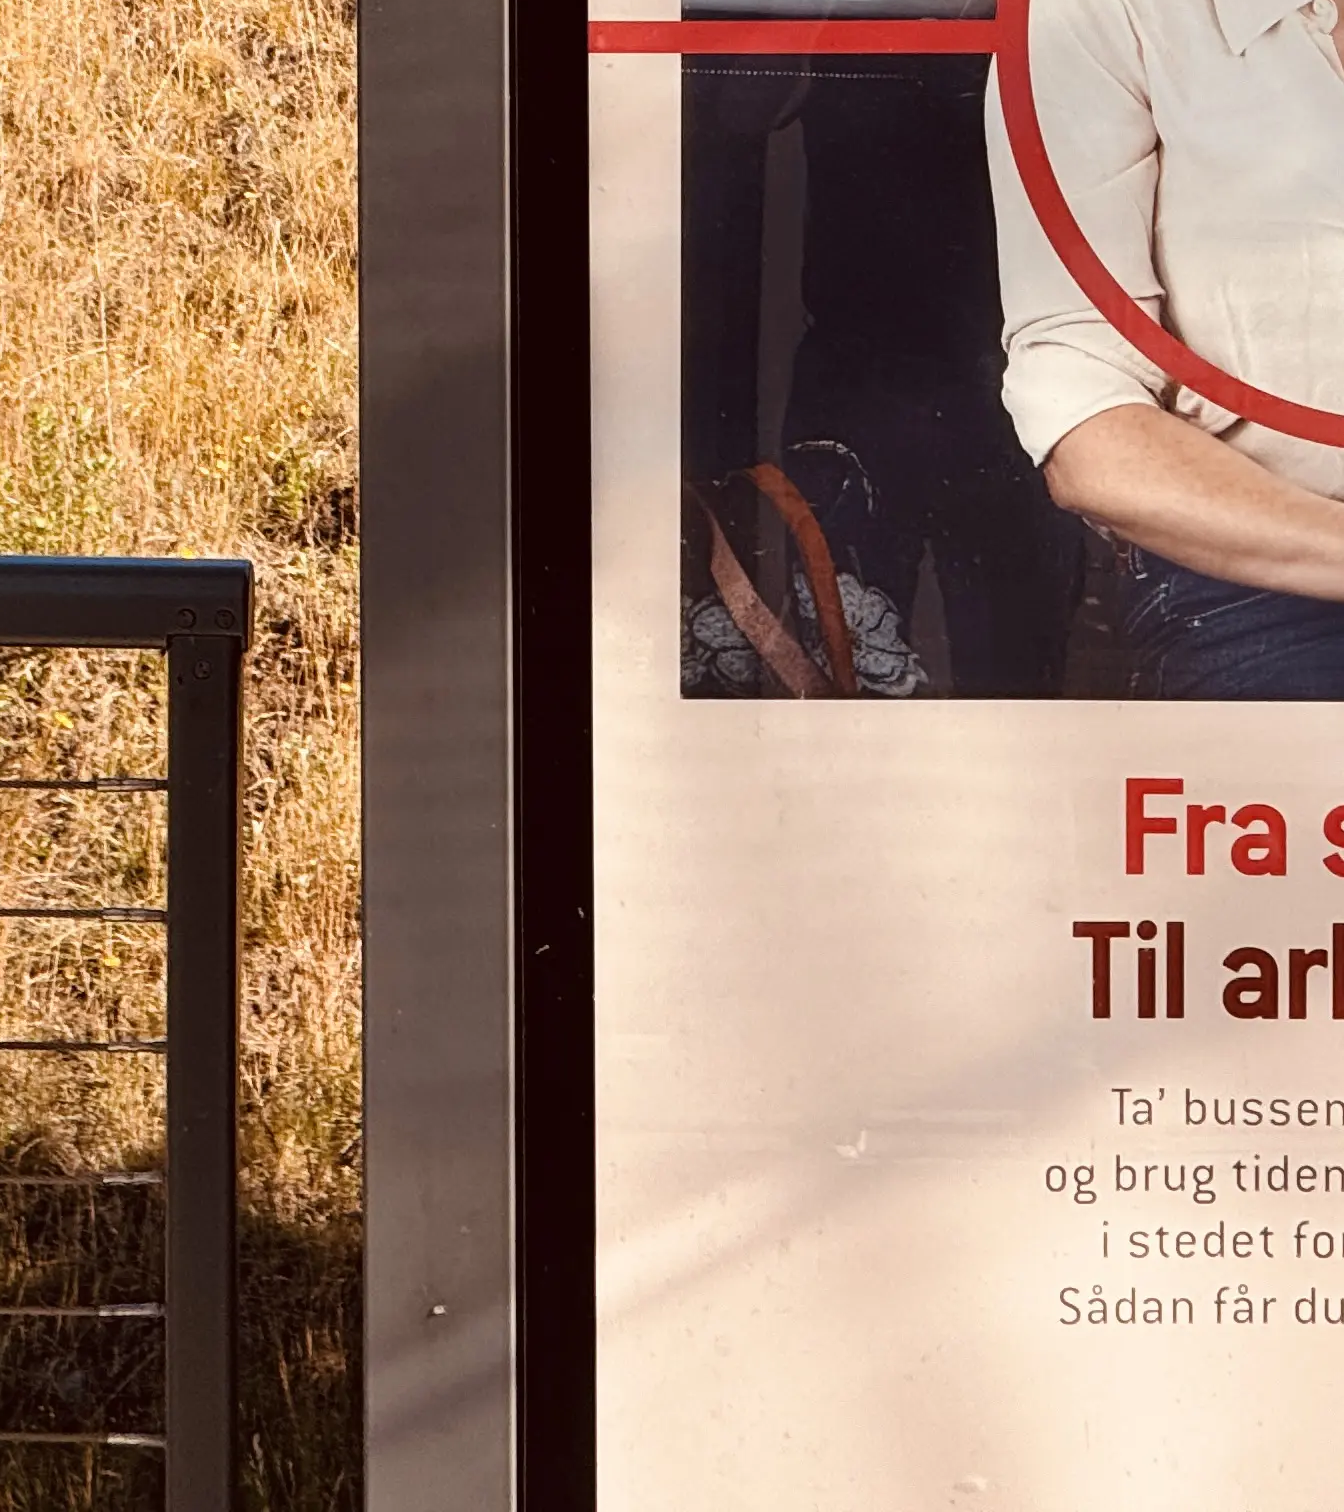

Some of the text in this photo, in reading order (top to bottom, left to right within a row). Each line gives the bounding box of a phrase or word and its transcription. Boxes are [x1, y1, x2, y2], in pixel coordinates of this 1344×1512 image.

[1126, 778, 1286, 876] Fra
[1073, 920, 1184, 1018] Til
[1046, 1165, 1096, 1204] og
[1116, 1155, 1216, 1204] brug
[1233, 1154, 1344, 1192] tiden
[1102, 1221, 1109, 1257] i
[1130, 1221, 1273, 1258] stedet
[1060, 1285, 1193, 1325] Sådan
[1214, 1284, 1276, 1323] får
[1295, 1287, 1344, 1324] du
